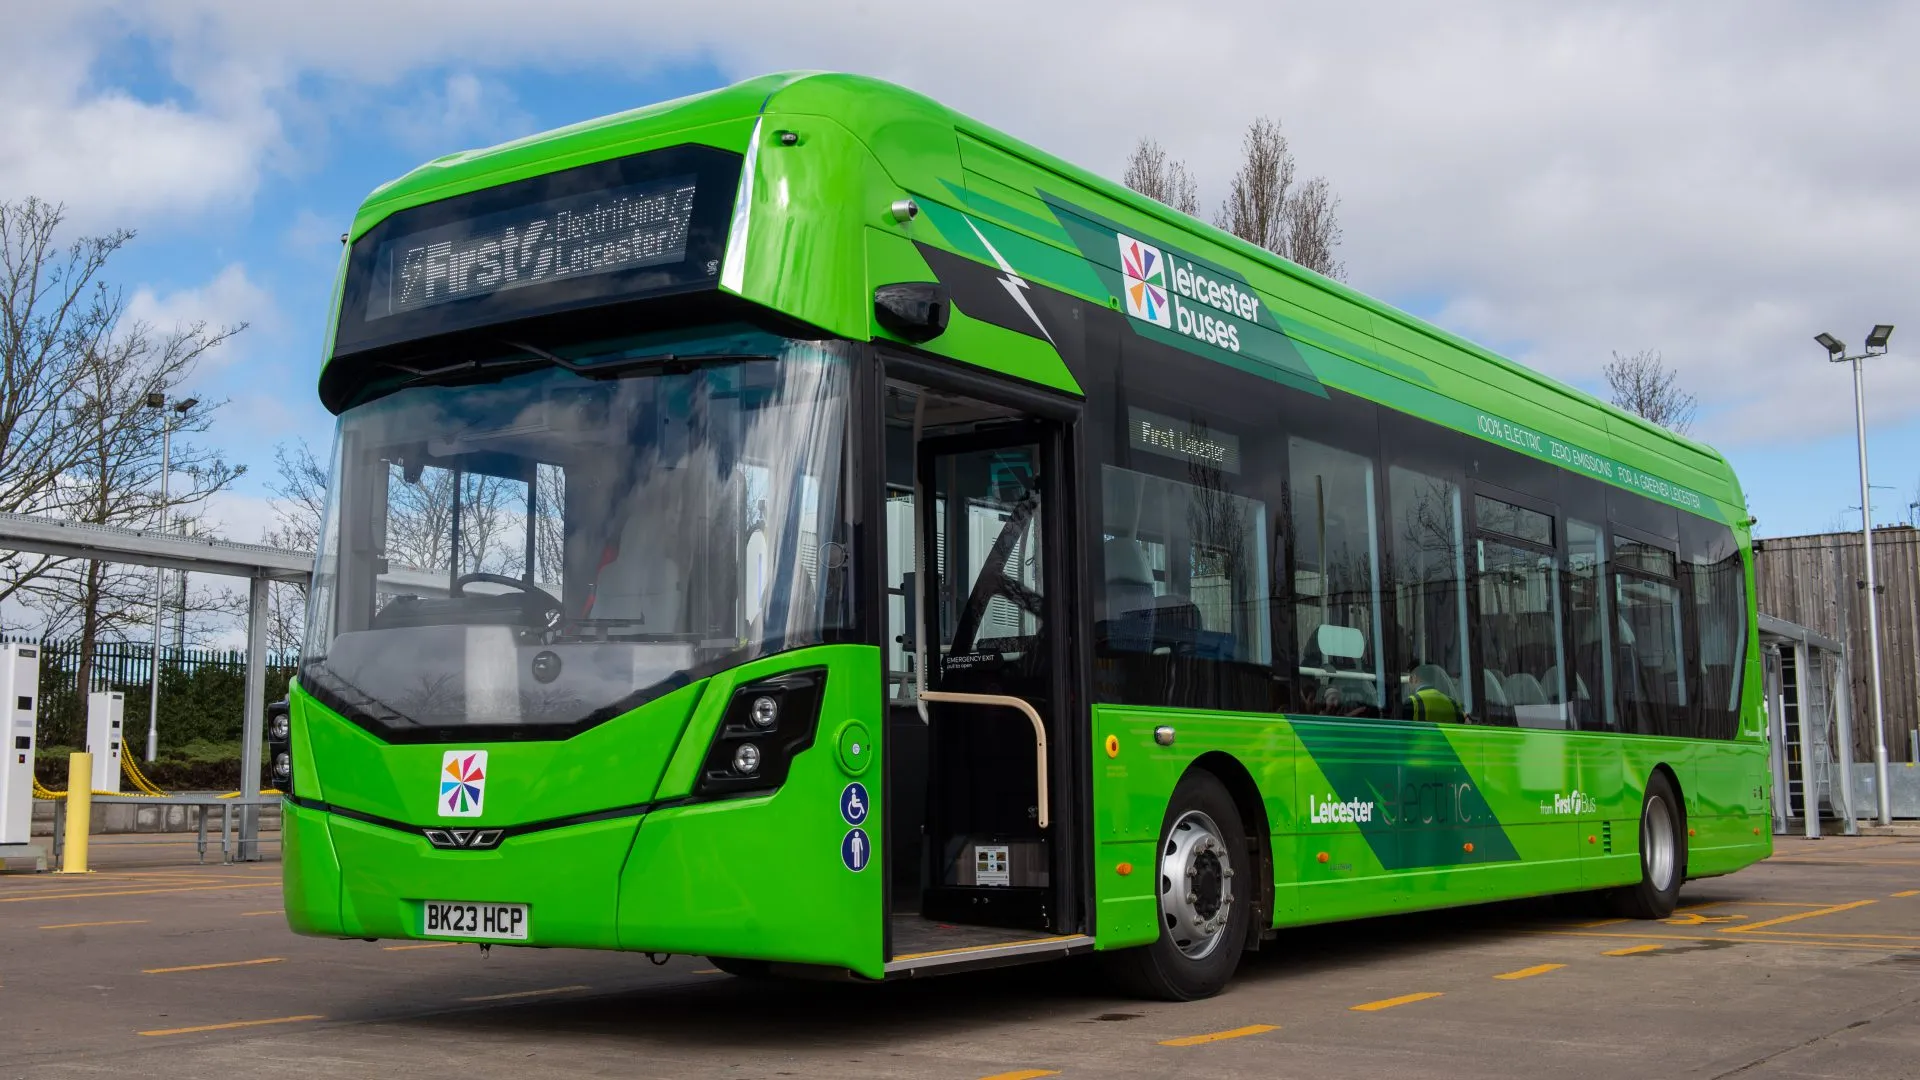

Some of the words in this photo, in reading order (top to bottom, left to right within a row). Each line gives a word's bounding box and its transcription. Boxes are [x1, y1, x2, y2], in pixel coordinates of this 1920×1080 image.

[556, 194, 666, 242] Electrifying
[425, 226, 519, 298] First
[555, 228, 668, 275] Leicester
[1167, 253, 1260, 323] leicester
[1174, 294, 1241, 352] buses
[1142, 421, 1175, 450] First
[1180, 430, 1226, 462] Leicester
[1477, 415, 1503, 438] 100%
[1503, 424, 1543, 453] ELECTRIC
[1549, 440, 1571, 463] ZERO
[1572, 449, 1613, 478] EMISSIONS
[1617, 466, 1633, 485] FOR
[1640, 474, 1670, 498] GREENER
[1669, 484, 1701, 510] LEICESTER
[981, 654, 995, 662] EXIT
[1310, 793, 1374, 824] Leicester
[1540, 799, 1554, 815] from
[1554, 793, 1571, 815] First
[428, 904, 478, 931] BK23
[483, 906, 523, 934] HCP
